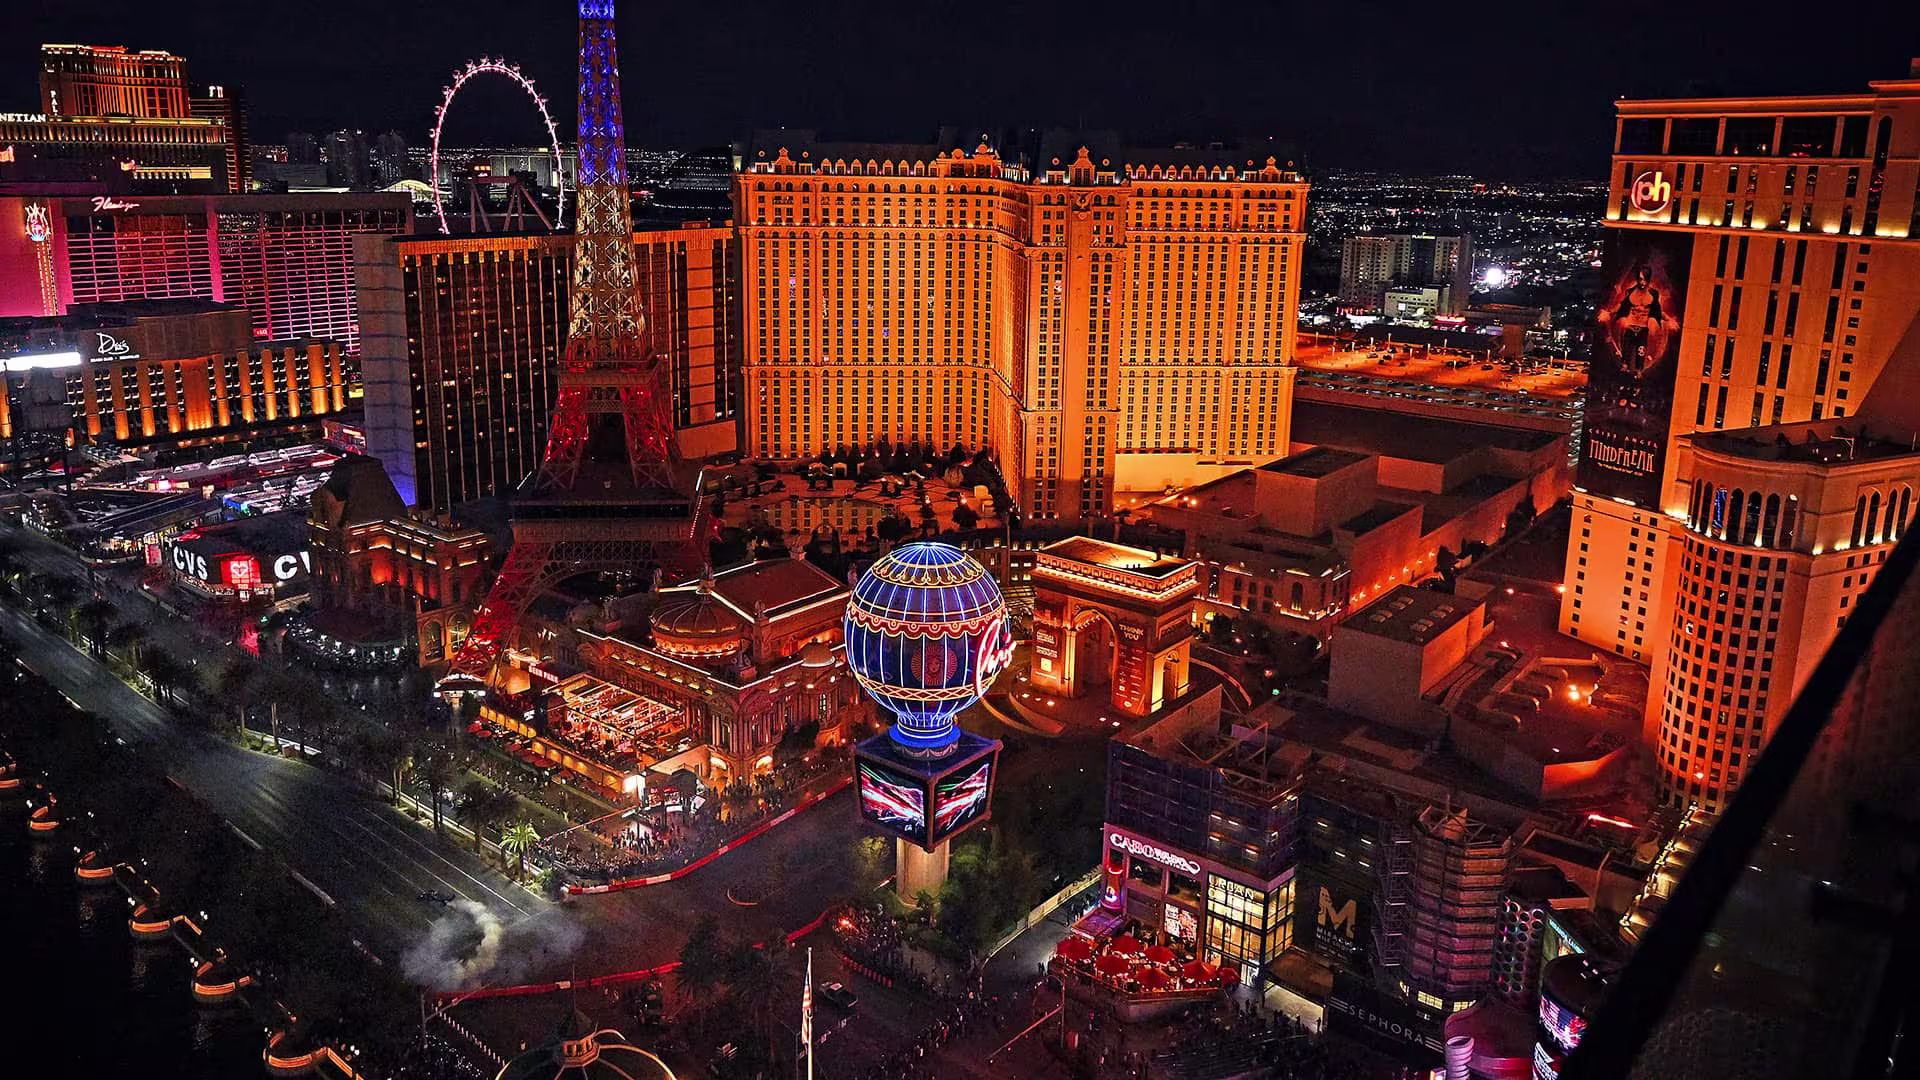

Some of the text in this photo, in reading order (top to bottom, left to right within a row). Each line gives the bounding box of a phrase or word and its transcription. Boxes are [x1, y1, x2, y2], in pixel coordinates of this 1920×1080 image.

[91, 196, 140, 212] Flamingo
[173, 545, 208, 580] CVS
[1124, 632, 1139, 641] YOU
[976, 618, 1017, 697] Paris
[1110, 833, 1154, 859] CABO
[1348, 1004, 1424, 1046] SEPHORA
